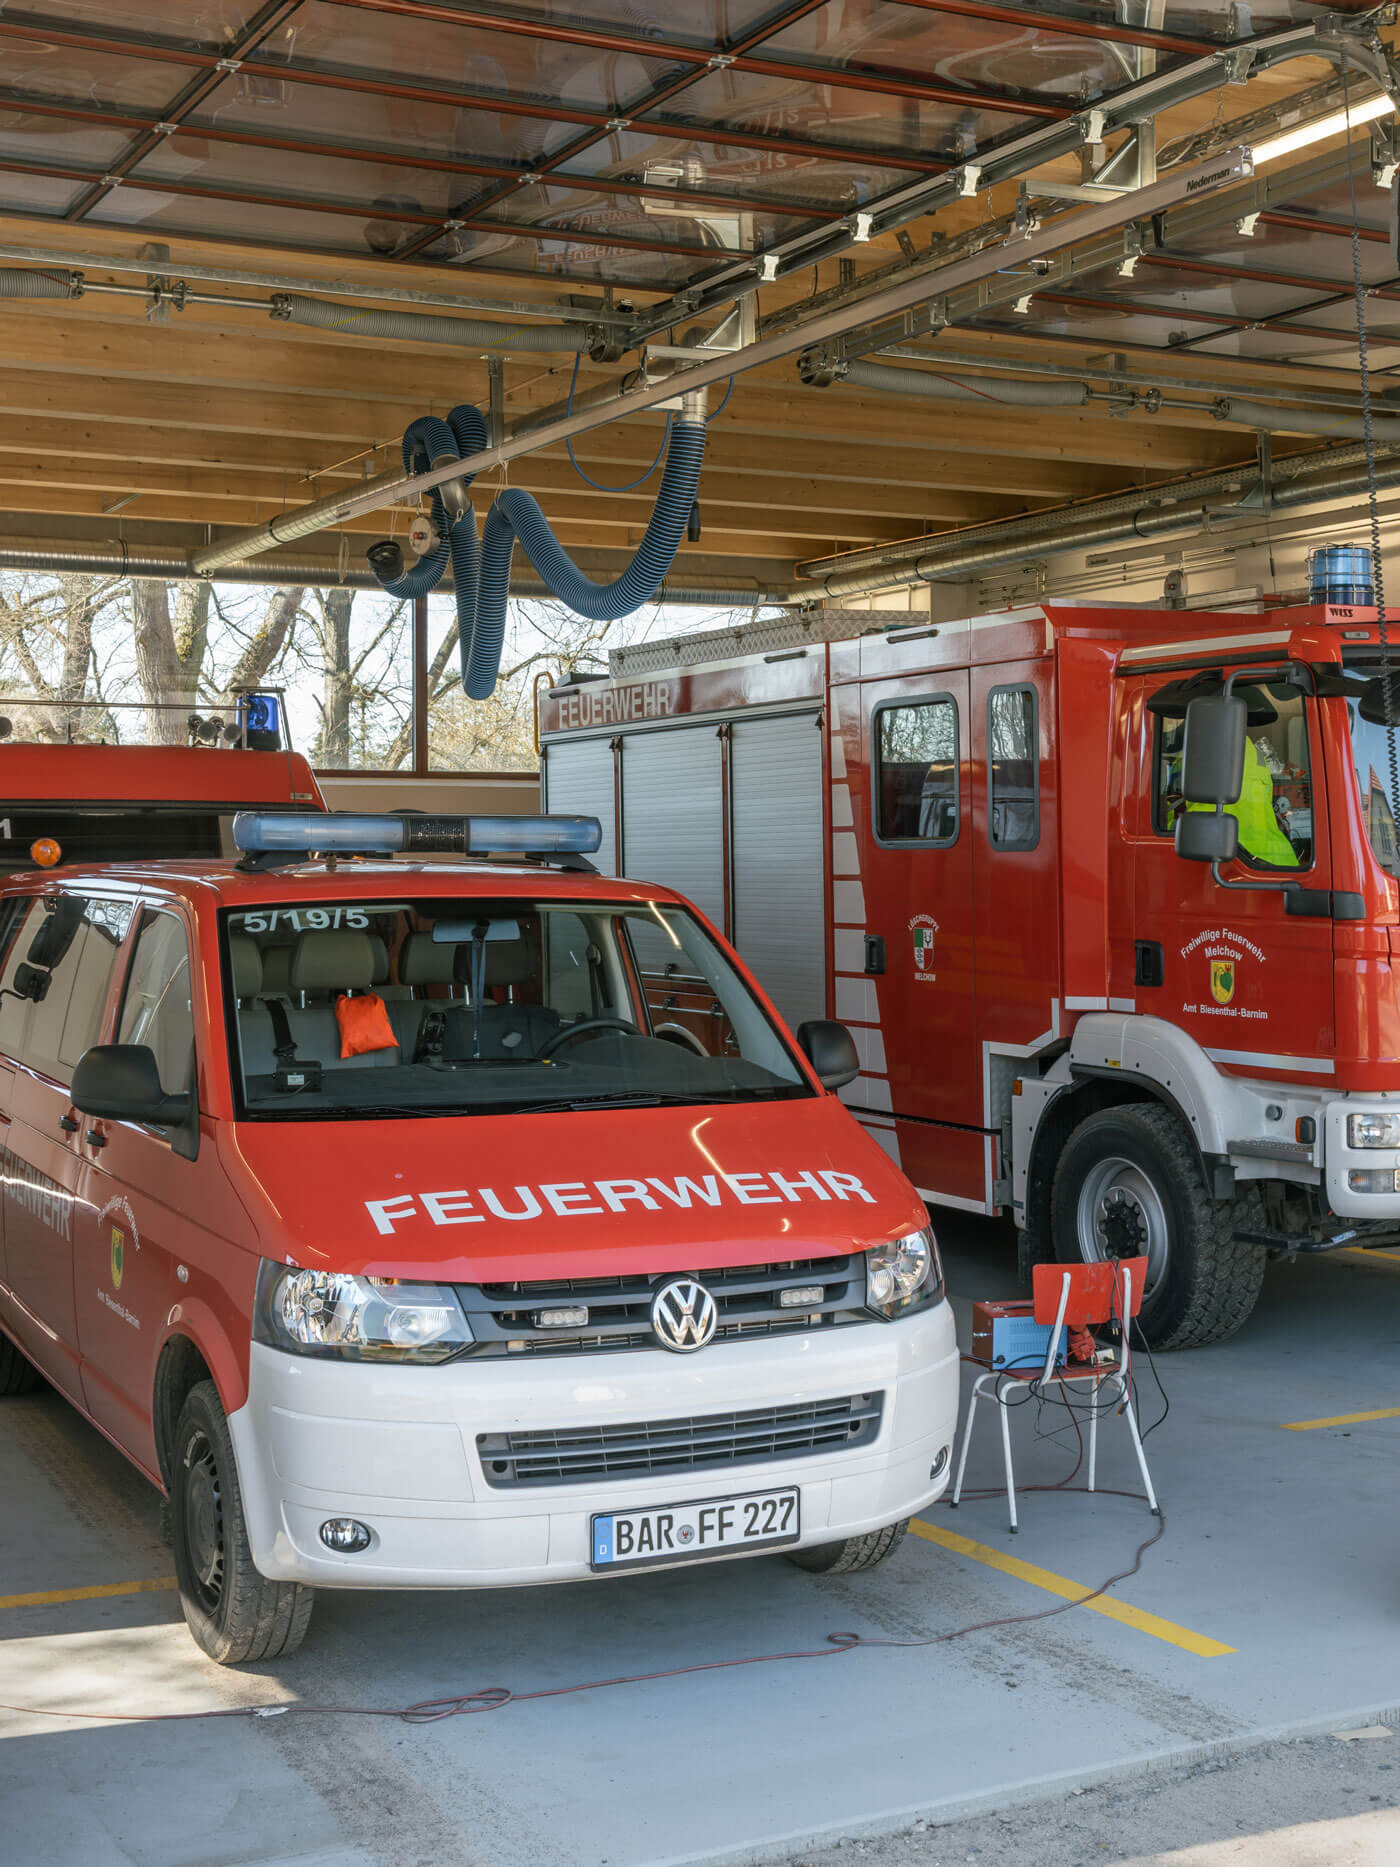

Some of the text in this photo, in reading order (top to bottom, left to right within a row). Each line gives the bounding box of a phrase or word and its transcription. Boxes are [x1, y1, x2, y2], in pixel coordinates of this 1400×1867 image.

[1187, 168, 1230, 192] Nederman
[558, 682, 674, 729] FEUERWEHR
[244, 908, 369, 933] 5/19/5
[1180, 927, 1267, 963] Freiwillige Feuerwehr
[1204, 945, 1243, 962] Melchow
[1182, 1002, 1268, 1020] Amt Biesenthal-Barnim
[364, 1170, 878, 1236] FEUERWEHR
[616, 1496, 796, 1556] BAR FF 227
[599, 1544, 608, 1555] D
